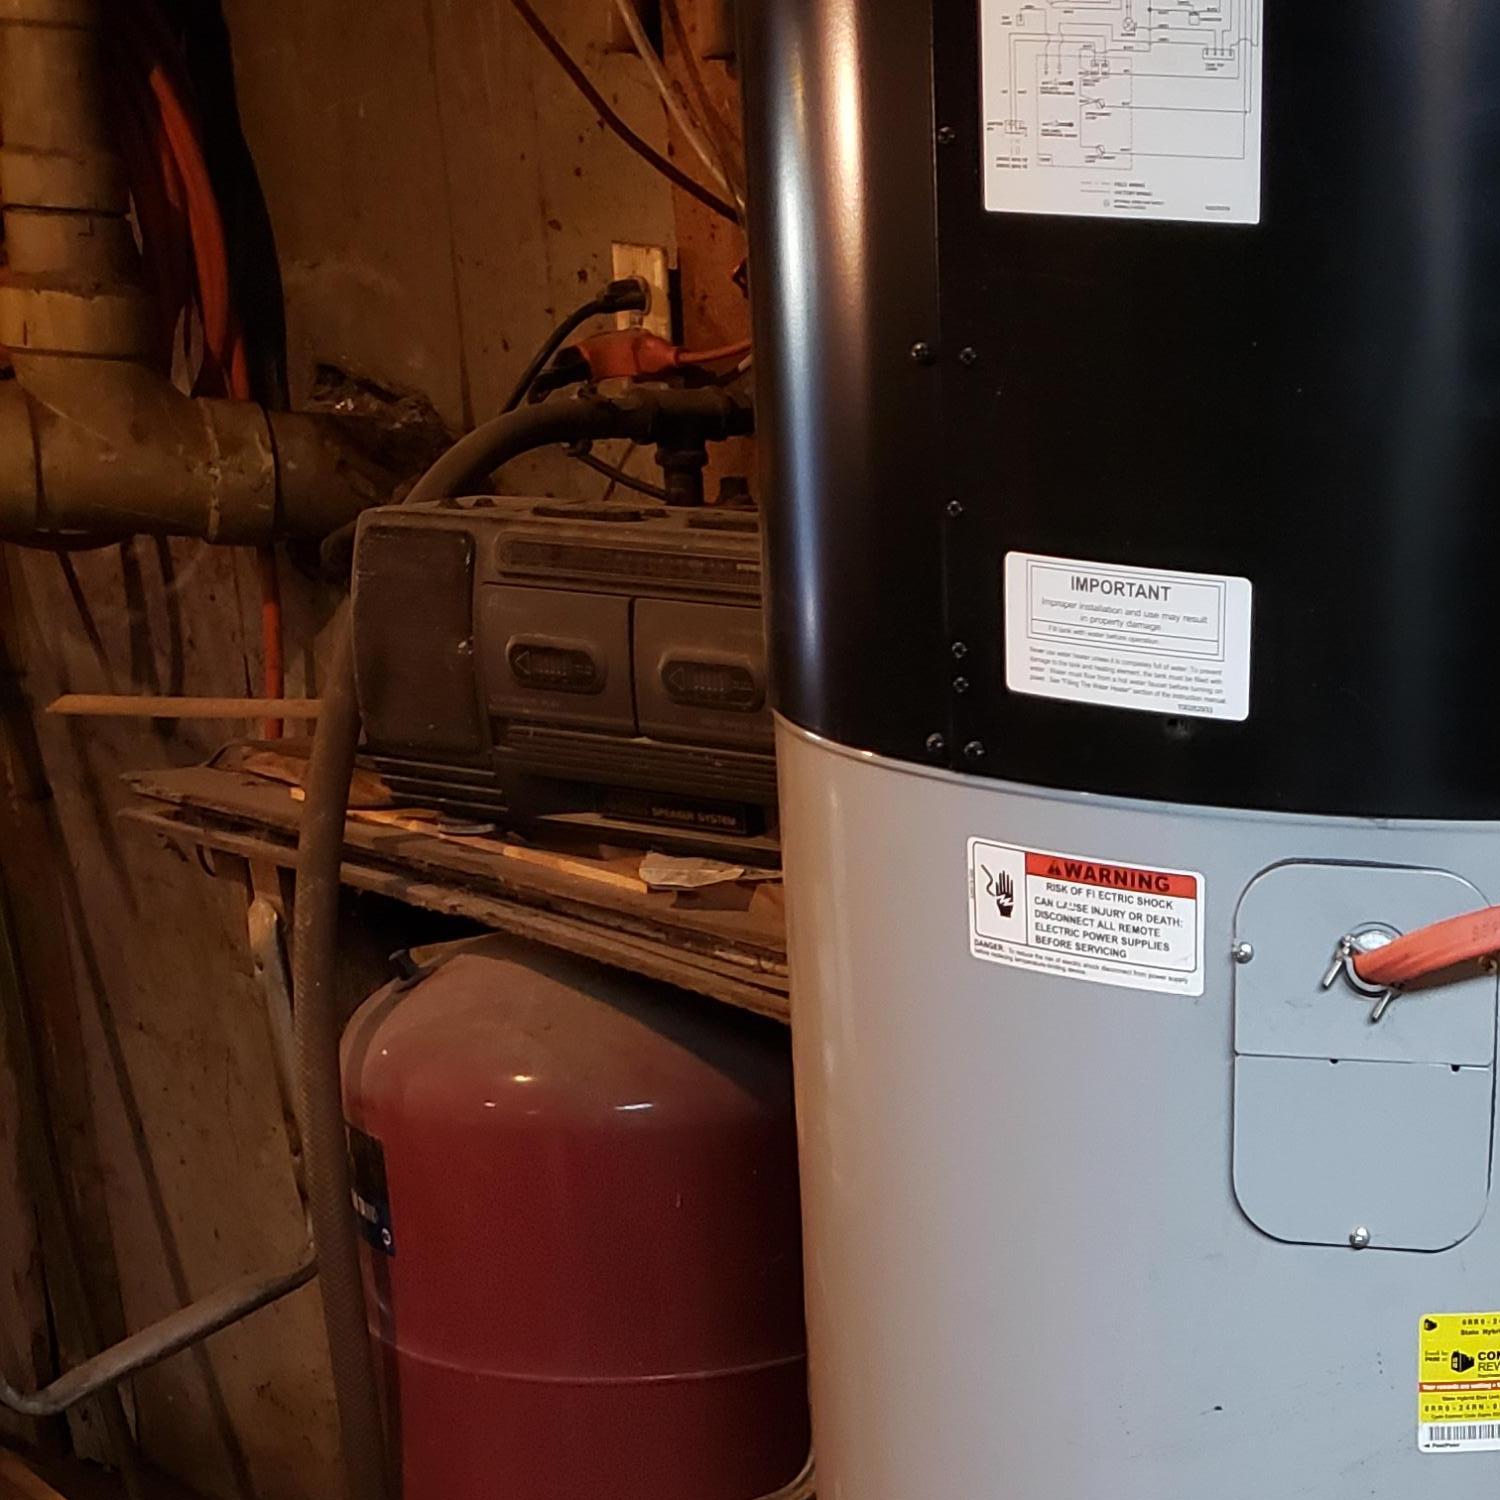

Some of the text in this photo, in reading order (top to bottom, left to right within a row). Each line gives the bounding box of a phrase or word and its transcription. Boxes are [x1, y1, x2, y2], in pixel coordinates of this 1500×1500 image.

[1071, 576, 1171, 602] IMPORTANT
[1089, 617, 1124, 628] property
[1125, 608, 1142, 617] and
[1162, 612, 1180, 623] may
[1064, 862, 1170, 892] WARNING
[1034, 896, 1053, 908] CAN
[1091, 906, 1125, 920] INJURY
[1128, 912, 1143, 922] OR
[1046, 883, 1068, 894] RISK
[1070, 887, 1085, 896] OF
[1137, 897, 1173, 910] SHOCK
[1034, 909, 1161, 938] DISCONNECT ALL REMOTE
[1035, 923, 1170, 952] ELECTRIC POWER SUPPLIES
[1035, 935, 1127, 959] BEFORE SERVICING
